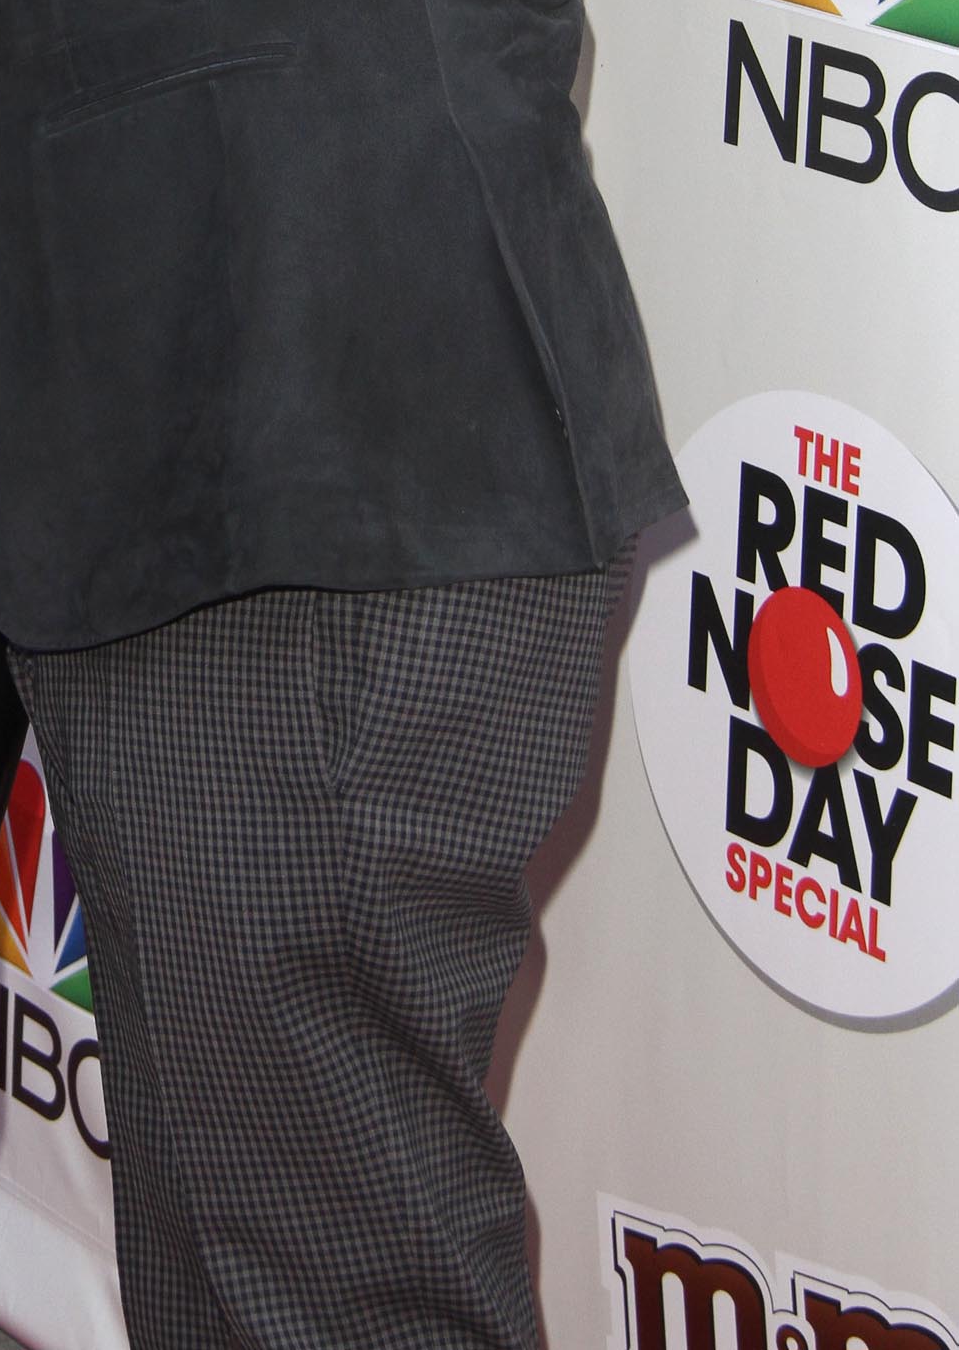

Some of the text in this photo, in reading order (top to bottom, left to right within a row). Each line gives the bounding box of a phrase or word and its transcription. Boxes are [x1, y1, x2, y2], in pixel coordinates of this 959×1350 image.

[794, 425, 861, 496] THE
[736, 461, 926, 640] RED
[725, 715, 918, 907] DAY
[725, 841, 887, 963] SPECIAL
